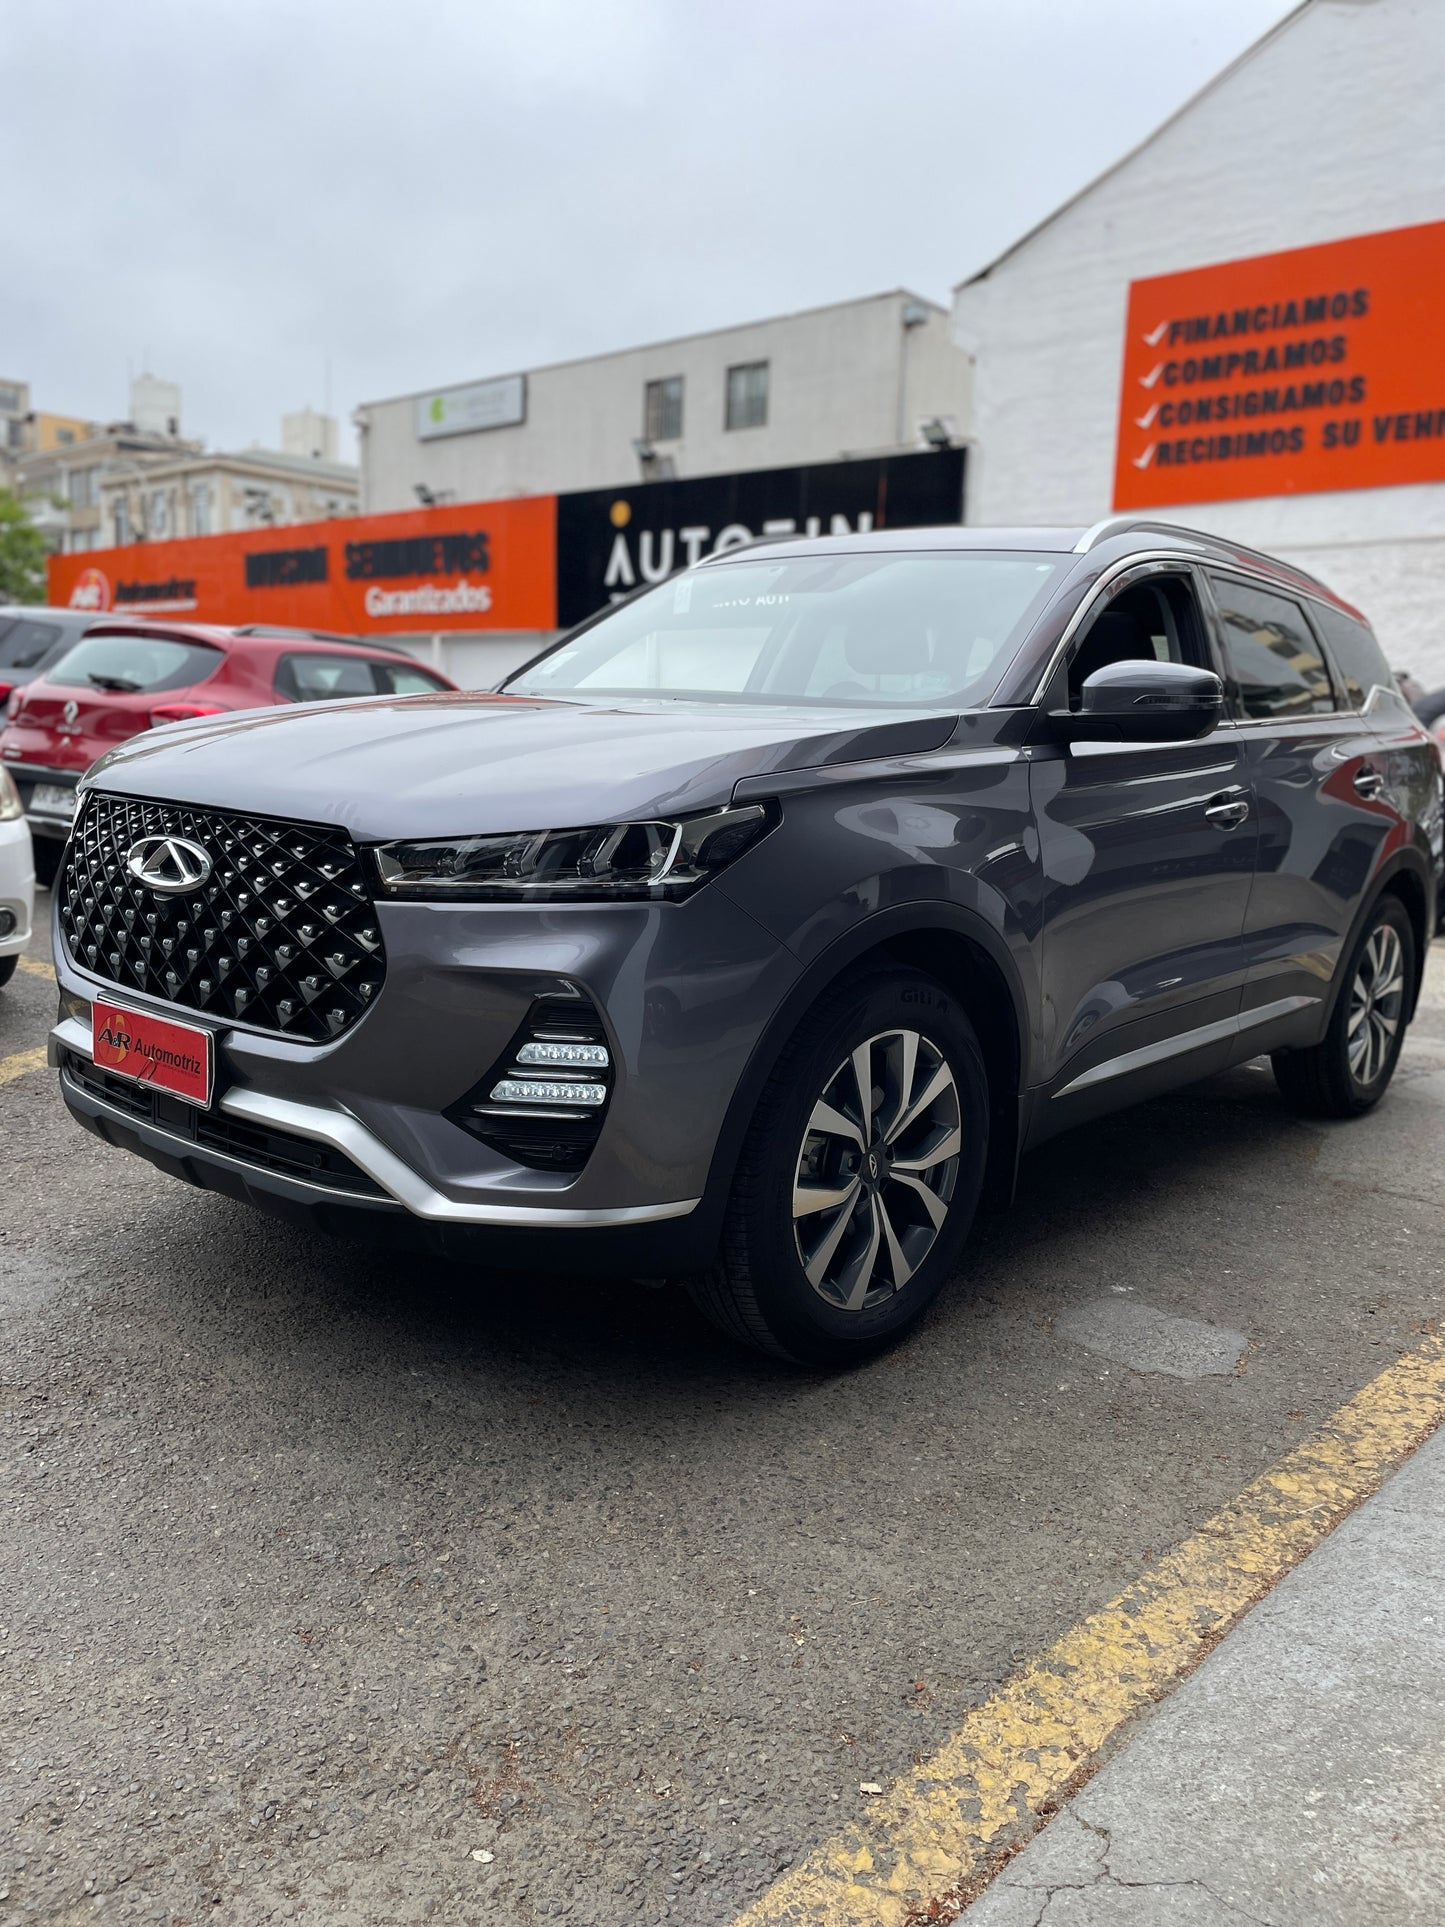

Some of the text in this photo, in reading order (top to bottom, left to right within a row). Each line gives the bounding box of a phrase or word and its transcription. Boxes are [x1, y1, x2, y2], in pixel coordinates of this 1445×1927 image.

[1168, 288, 1369, 345] FINANCIAMOS
[1163, 335, 1346, 386] COMPRAMOS
[1158, 375, 1366, 427] CONSIGNAMOS
[1155, 426, 1304, 467] RECIBIMOS
[1322, 420, 1361, 449] SU
[134, 1038, 201, 1075] Automotriz
